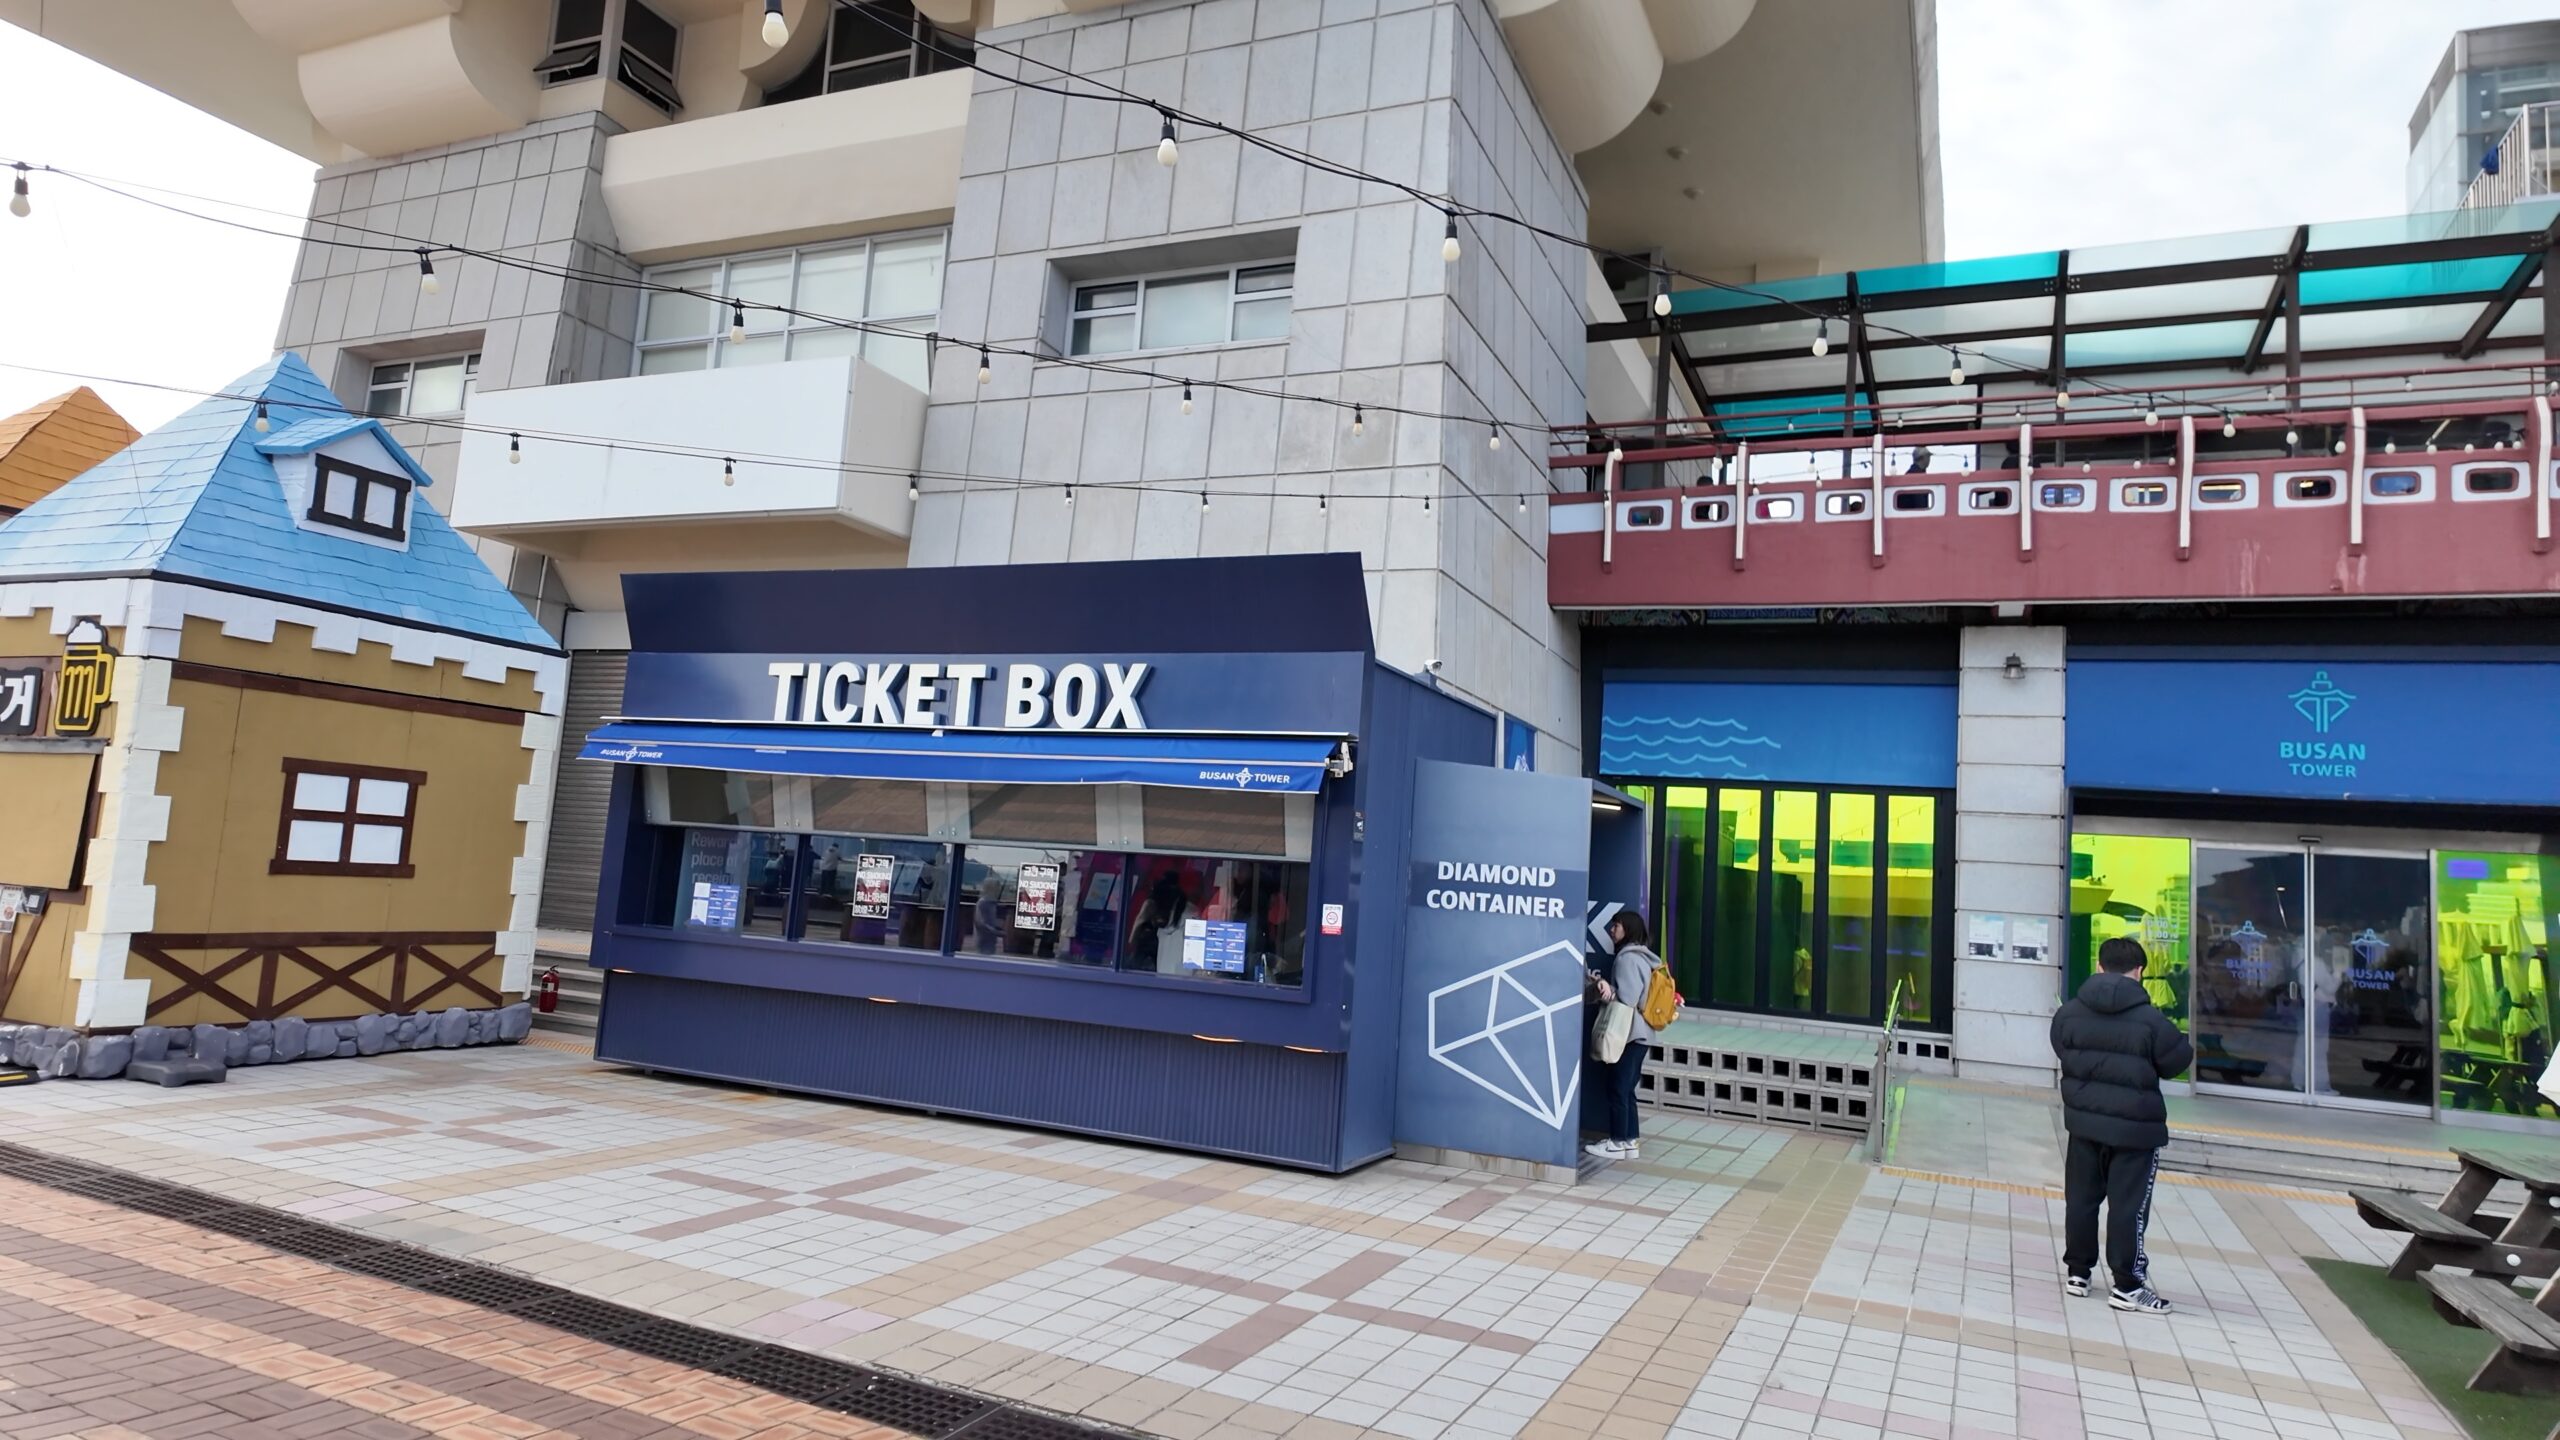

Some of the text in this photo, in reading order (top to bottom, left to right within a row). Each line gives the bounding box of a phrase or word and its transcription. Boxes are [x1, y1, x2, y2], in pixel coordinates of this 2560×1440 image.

[0, 674, 36, 727] 거
[768, 661, 1152, 729] TICKET BOX
[600, 748, 663, 759] BUSAN TOWER
[2279, 741, 2366, 760] BUSAN
[1199, 771, 1291, 783] BUSAN TOWER
[2287, 763, 2358, 777] TOWER
[1437, 860, 1556, 888] DIAMOND
[1028, 889, 1046, 898] ZONE
[1426, 889, 1565, 918] CONTAINER
[2352, 980, 2390, 990] TOWER
